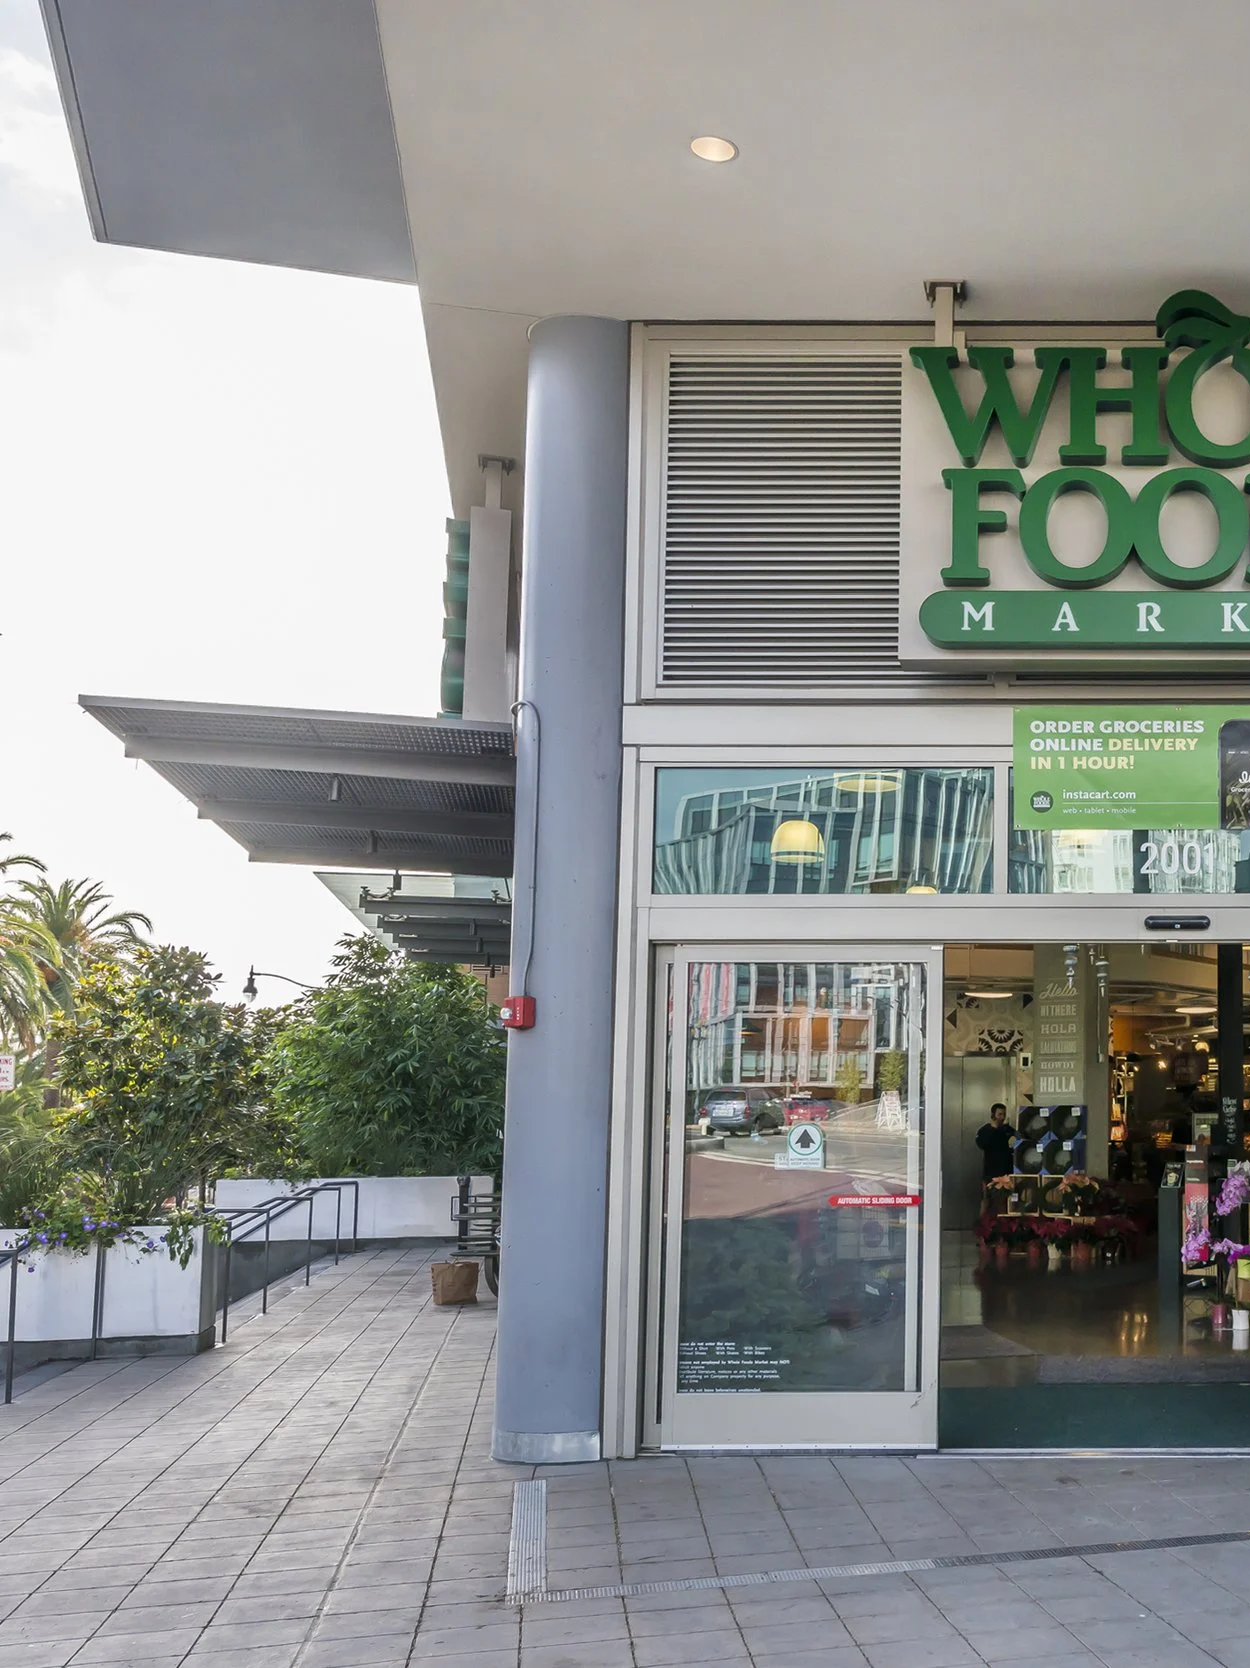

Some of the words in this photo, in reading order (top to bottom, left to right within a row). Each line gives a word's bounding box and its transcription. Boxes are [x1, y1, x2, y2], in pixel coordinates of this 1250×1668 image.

[1030, 720, 1095, 733] ORDER
[1100, 720, 1204, 733] GROCERIES
[1030, 738, 1103, 751] ONLINE
[1108, 738, 1199, 751] DELIVERY
[1030, 756, 1051, 769] IN
[1057, 756, 1065, 769] 1
[1073, 756, 1135, 769] HOUR!
[1063, 789, 1136, 799] instacart.com
[1140, 842, 1215, 874] 2001
[1039, 983, 1078, 999] Hello
[1051, 1004, 1077, 1016] THERE
[1041, 1023, 1077, 1034] HOLA
[1040, 1076, 1076, 1093] HOLLA
